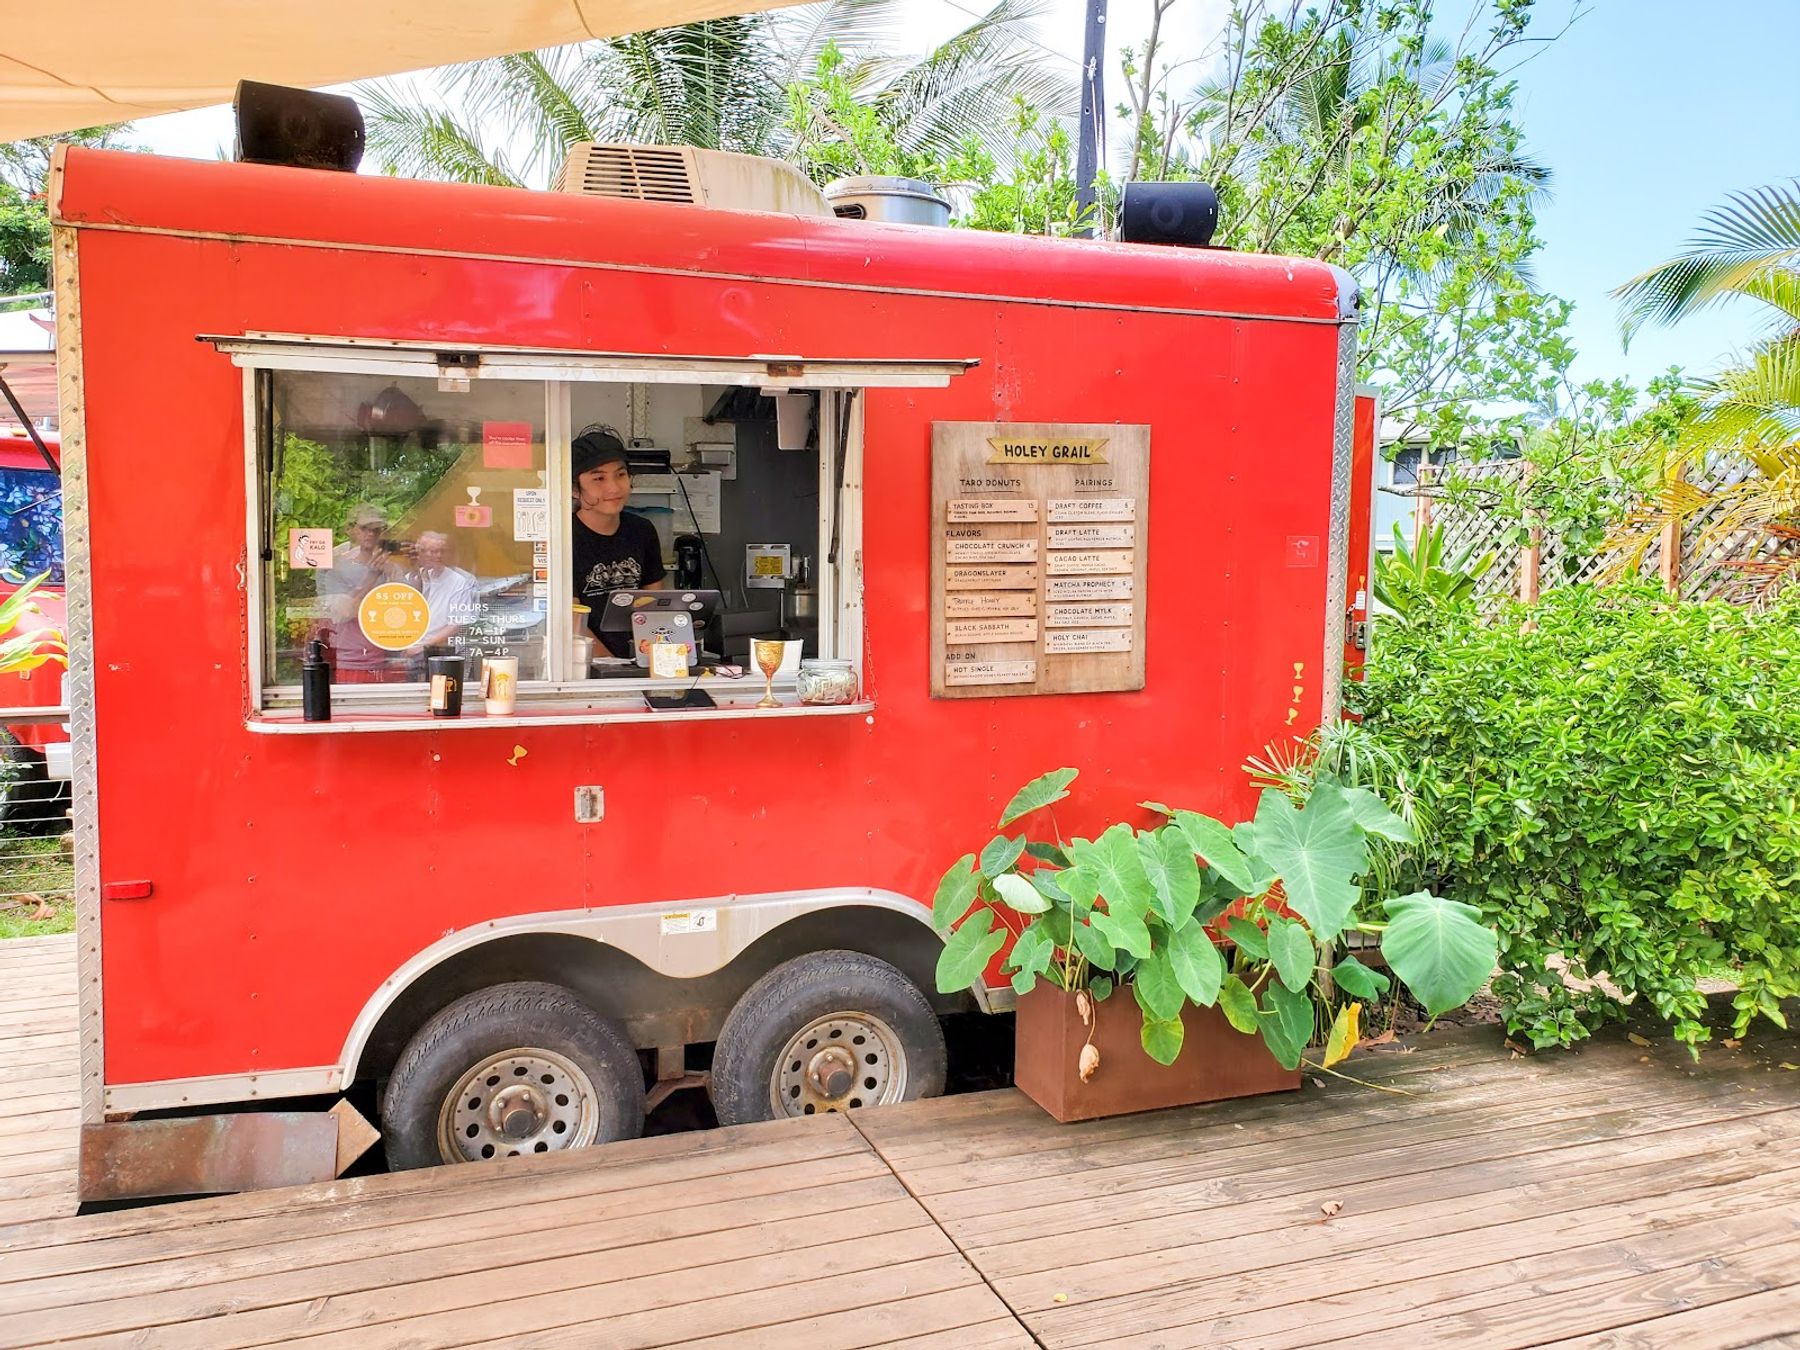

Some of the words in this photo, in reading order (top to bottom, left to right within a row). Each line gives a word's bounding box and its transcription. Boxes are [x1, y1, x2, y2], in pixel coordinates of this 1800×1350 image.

[1004, 444, 1048, 457] HOLEY
[1052, 446, 1091, 458] GRAIL
[959, 479, 983, 487] TARO
[985, 479, 1021, 487] DONUTS
[1074, 479, 1113, 487] PAIRINGS
[393, 592, 414, 601] OFF
[449, 603, 489, 612] HOURS
[447, 615, 477, 624] TUES
[490, 615, 526, 624] THURS
[447, 636, 466, 646] FRI
[482, 636, 506, 645] SUN
